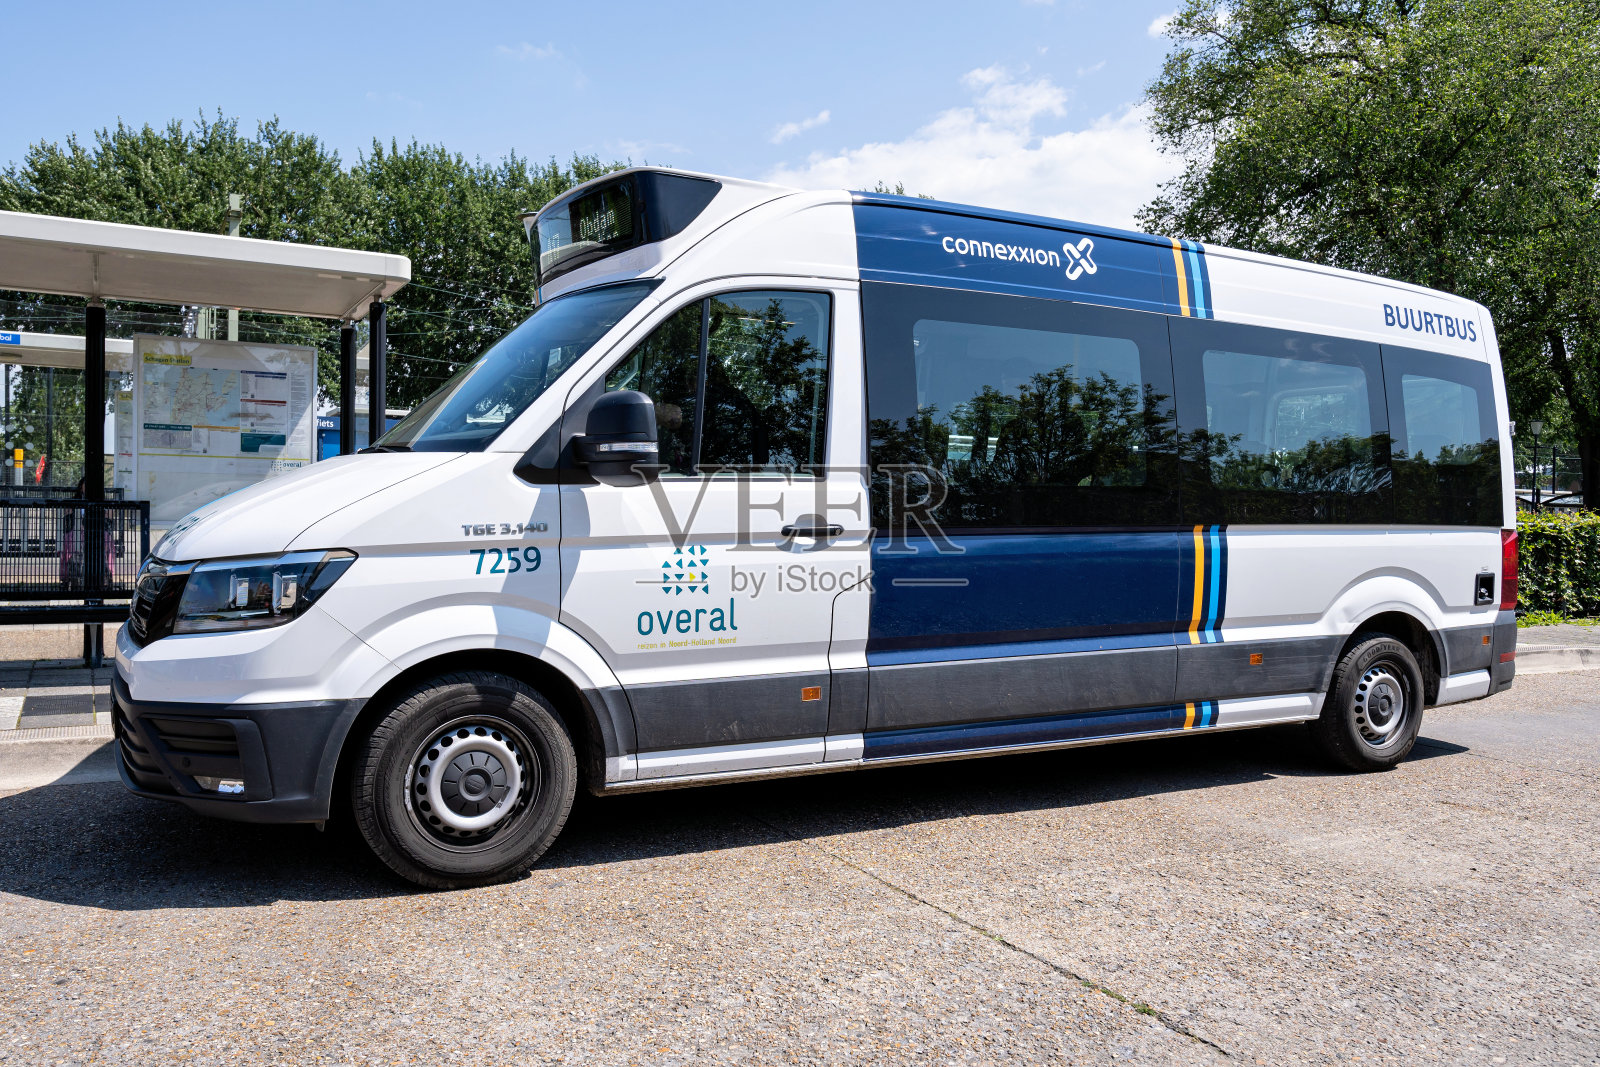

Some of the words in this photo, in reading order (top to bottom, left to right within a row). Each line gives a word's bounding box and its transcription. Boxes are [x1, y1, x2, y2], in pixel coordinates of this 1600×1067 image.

[943, 236, 1060, 268] connexxion
[1383, 303, 1477, 342] BUURTBUS
[461, 523, 497, 536] TGE
[470, 546, 542, 575] 7259
[637, 597, 738, 636] overal
[718, 636, 737, 645] Noord
